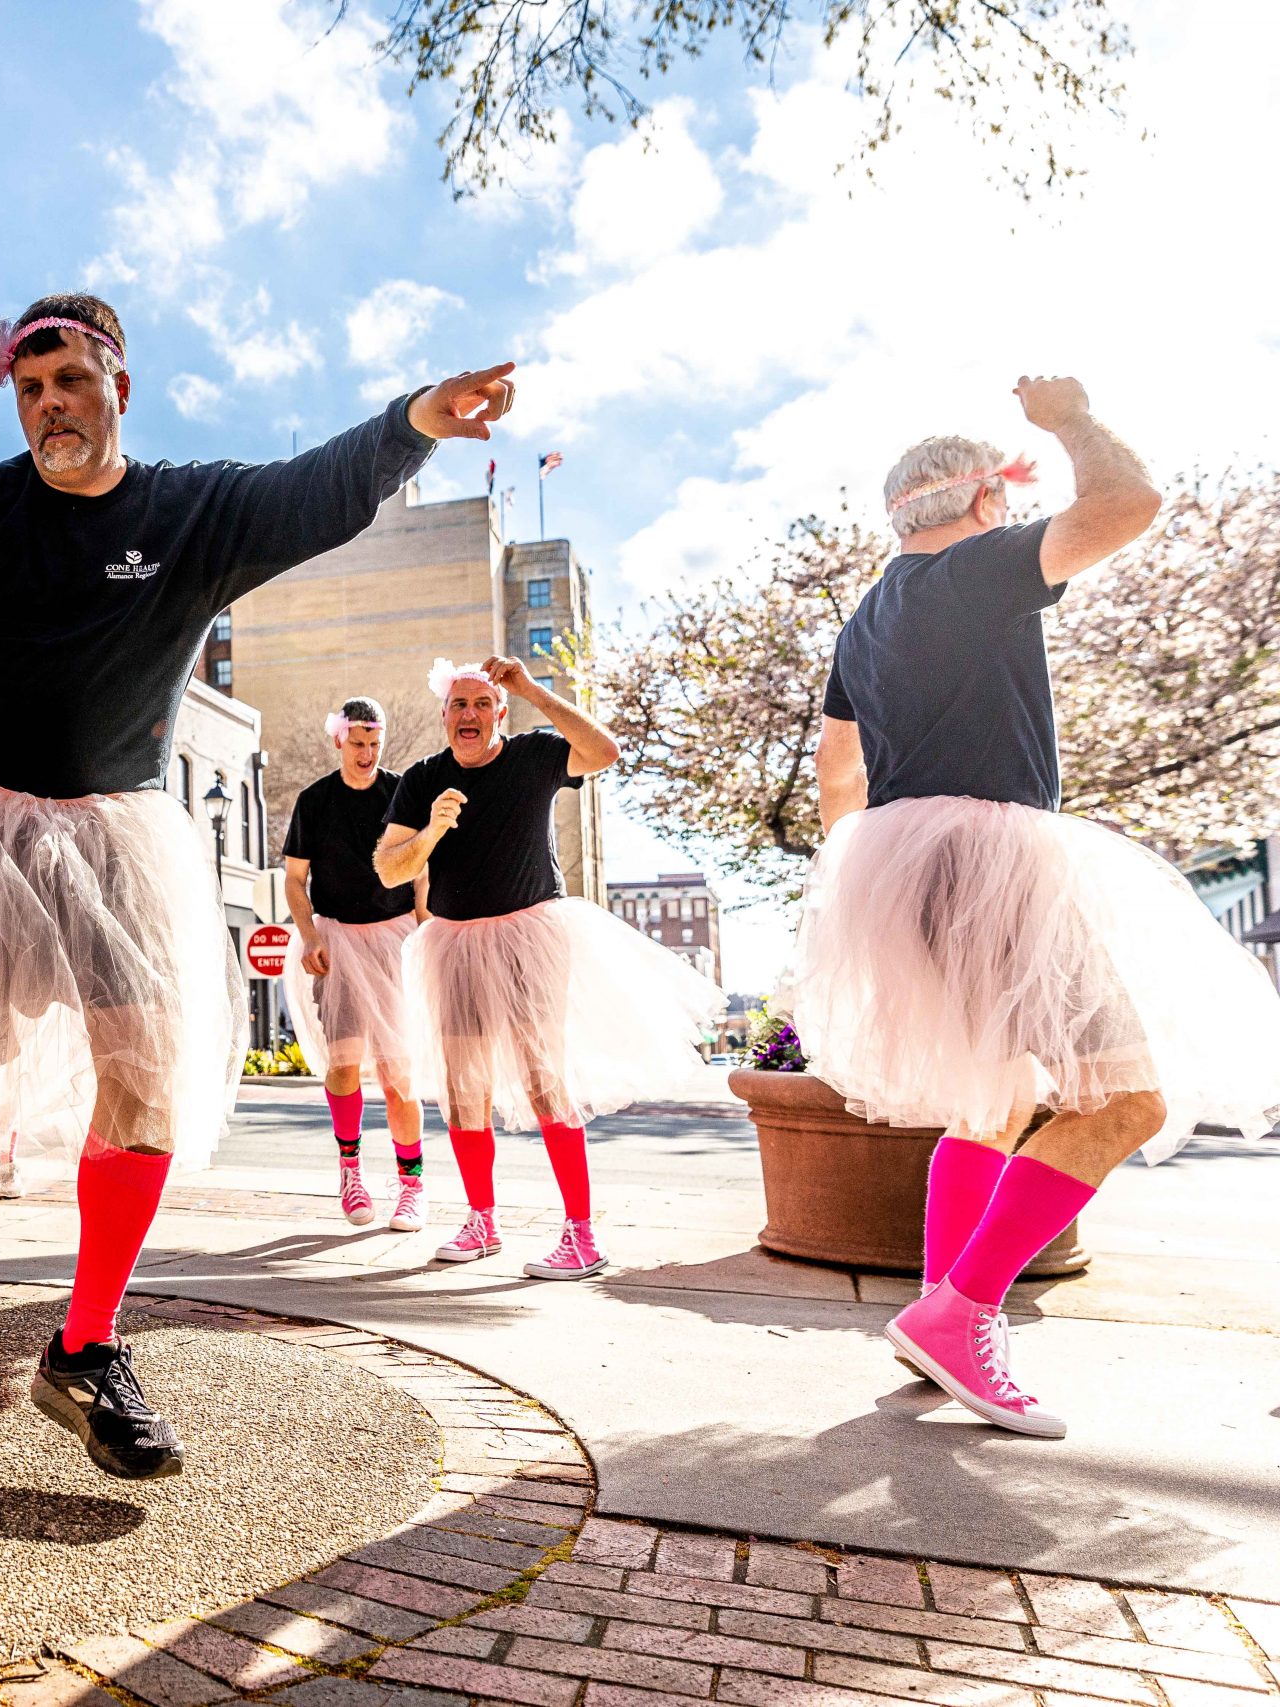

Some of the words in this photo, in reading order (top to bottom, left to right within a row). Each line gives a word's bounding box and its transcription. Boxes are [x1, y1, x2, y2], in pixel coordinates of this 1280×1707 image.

[105, 564, 131, 572] CONE
[106, 572, 134, 580] Alamance
[253, 934, 267, 944] DO
[271, 934, 289, 944] NOT
